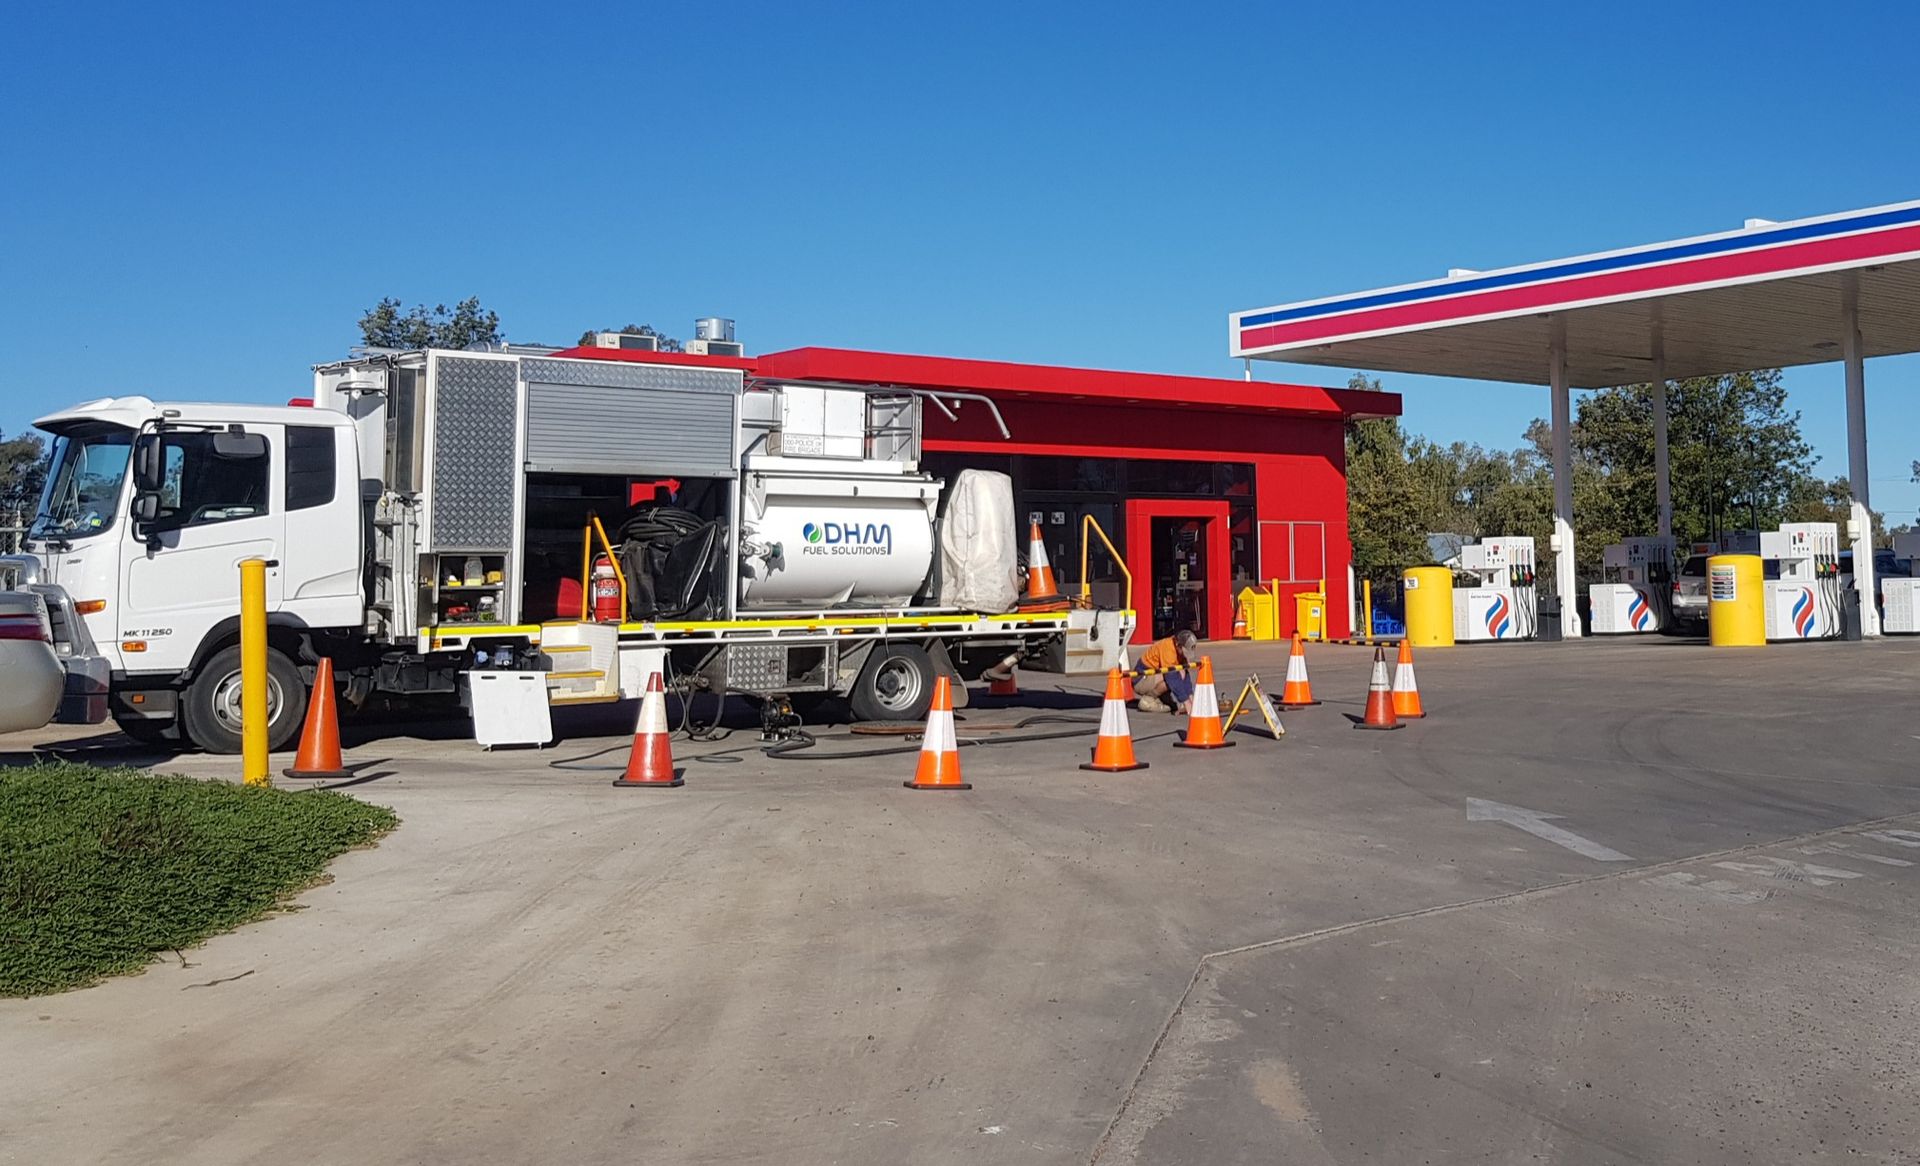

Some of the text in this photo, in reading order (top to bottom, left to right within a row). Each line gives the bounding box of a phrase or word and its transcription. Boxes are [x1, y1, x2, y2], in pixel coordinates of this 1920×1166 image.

[824, 522, 892, 555] DHM
[803, 546, 887, 555] FUEL SOLUTIONS
[151, 628, 173, 636] 250
